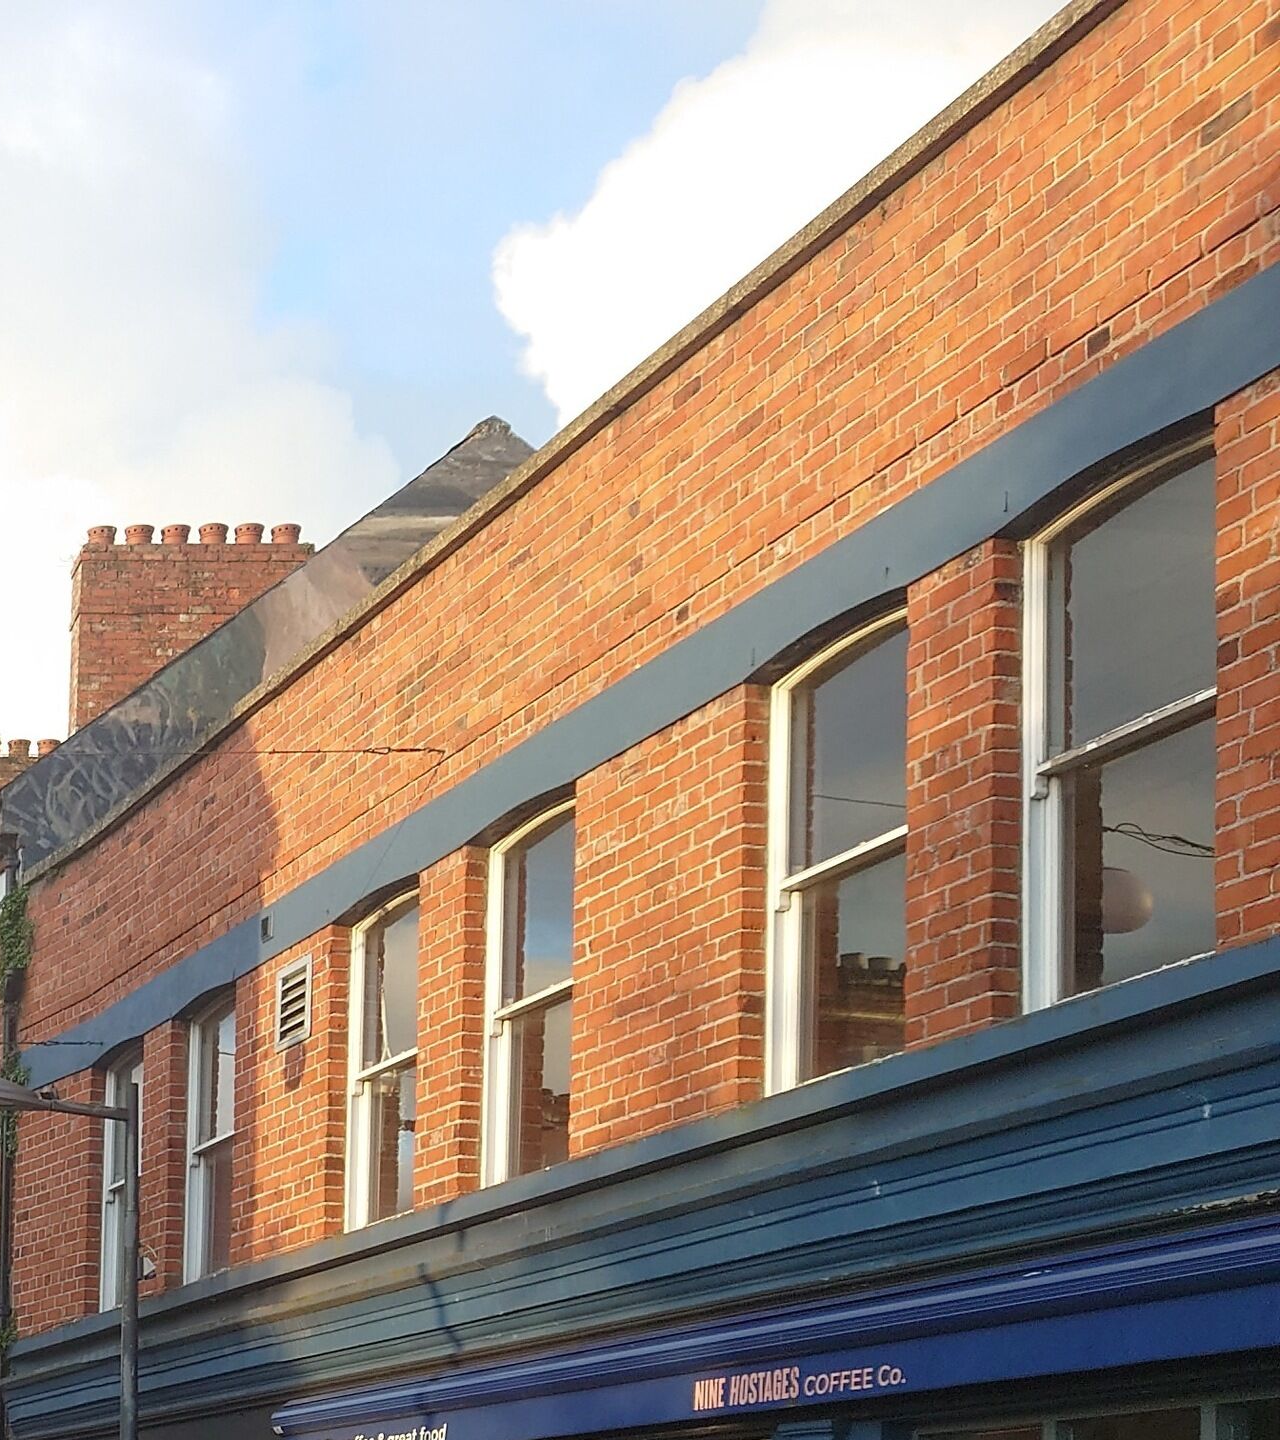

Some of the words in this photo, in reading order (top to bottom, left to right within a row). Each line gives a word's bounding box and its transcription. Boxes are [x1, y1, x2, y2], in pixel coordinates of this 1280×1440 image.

[693, 1378, 726, 1411] NINE
[729, 1366, 800, 1407] HOSTAGES
[804, 1367, 874, 1397] COFFEE
[877, 1364, 907, 1387] Co.
